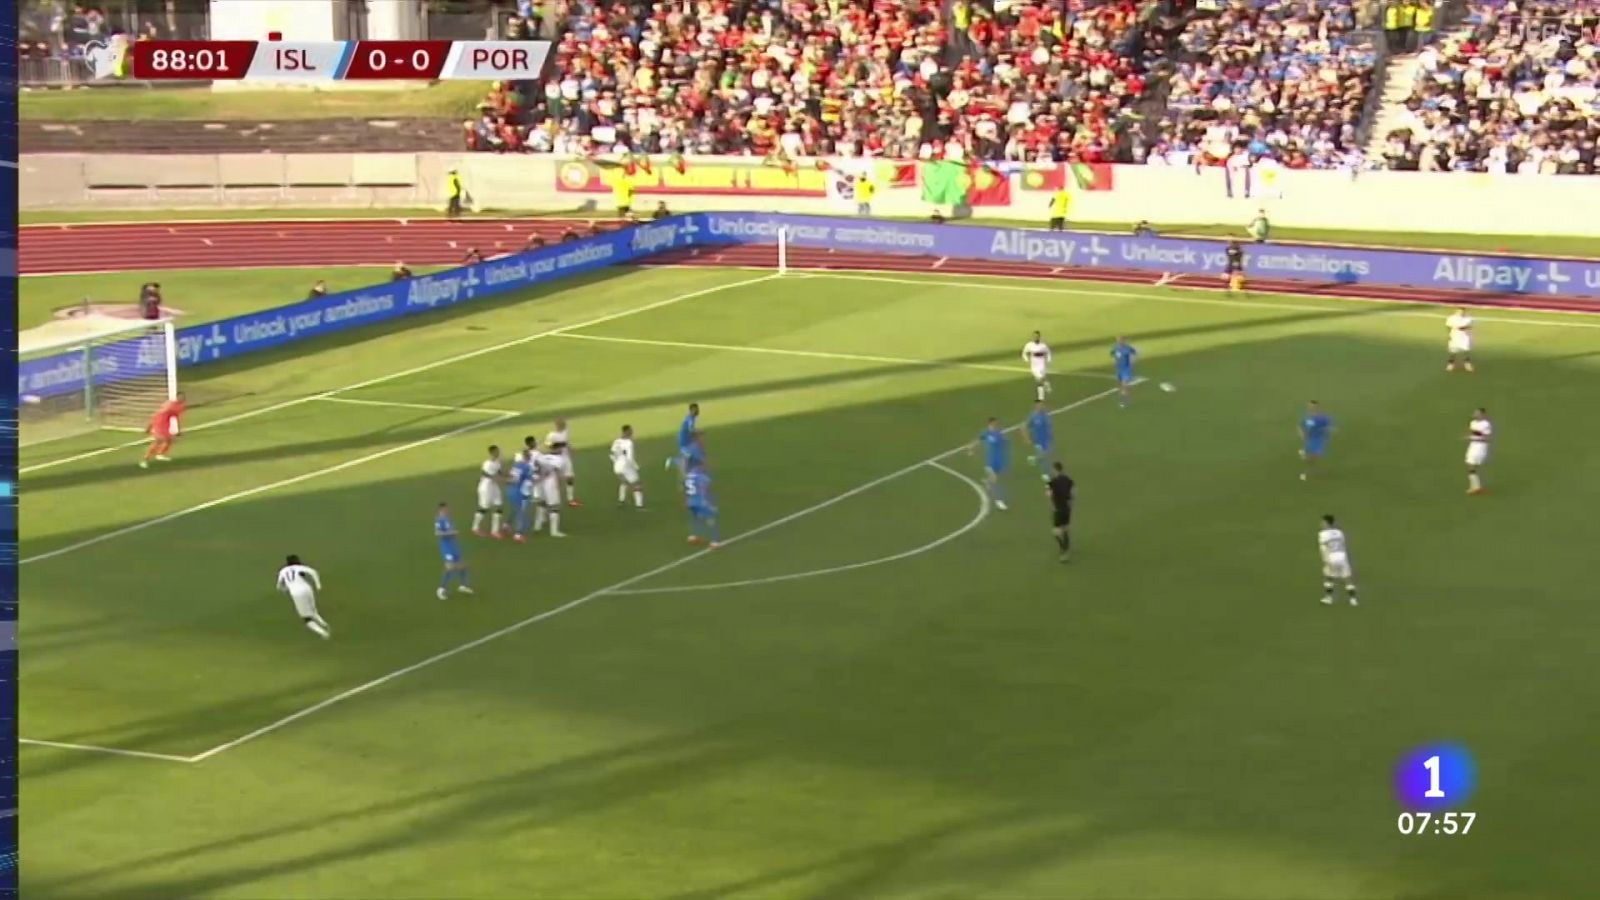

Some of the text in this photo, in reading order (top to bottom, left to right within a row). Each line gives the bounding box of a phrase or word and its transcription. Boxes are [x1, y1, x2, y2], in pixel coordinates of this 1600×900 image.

[632, 217, 935, 251] Alipay Unlock your ambitions
[991, 231, 1371, 275] Alipay Unlock yor ambitions
[407, 242, 614, 306] Alipay Unlock your ambitions
[1433, 256, 1532, 290] Alipay
[135, 294, 394, 369] Aliay Unlock your ambitions
